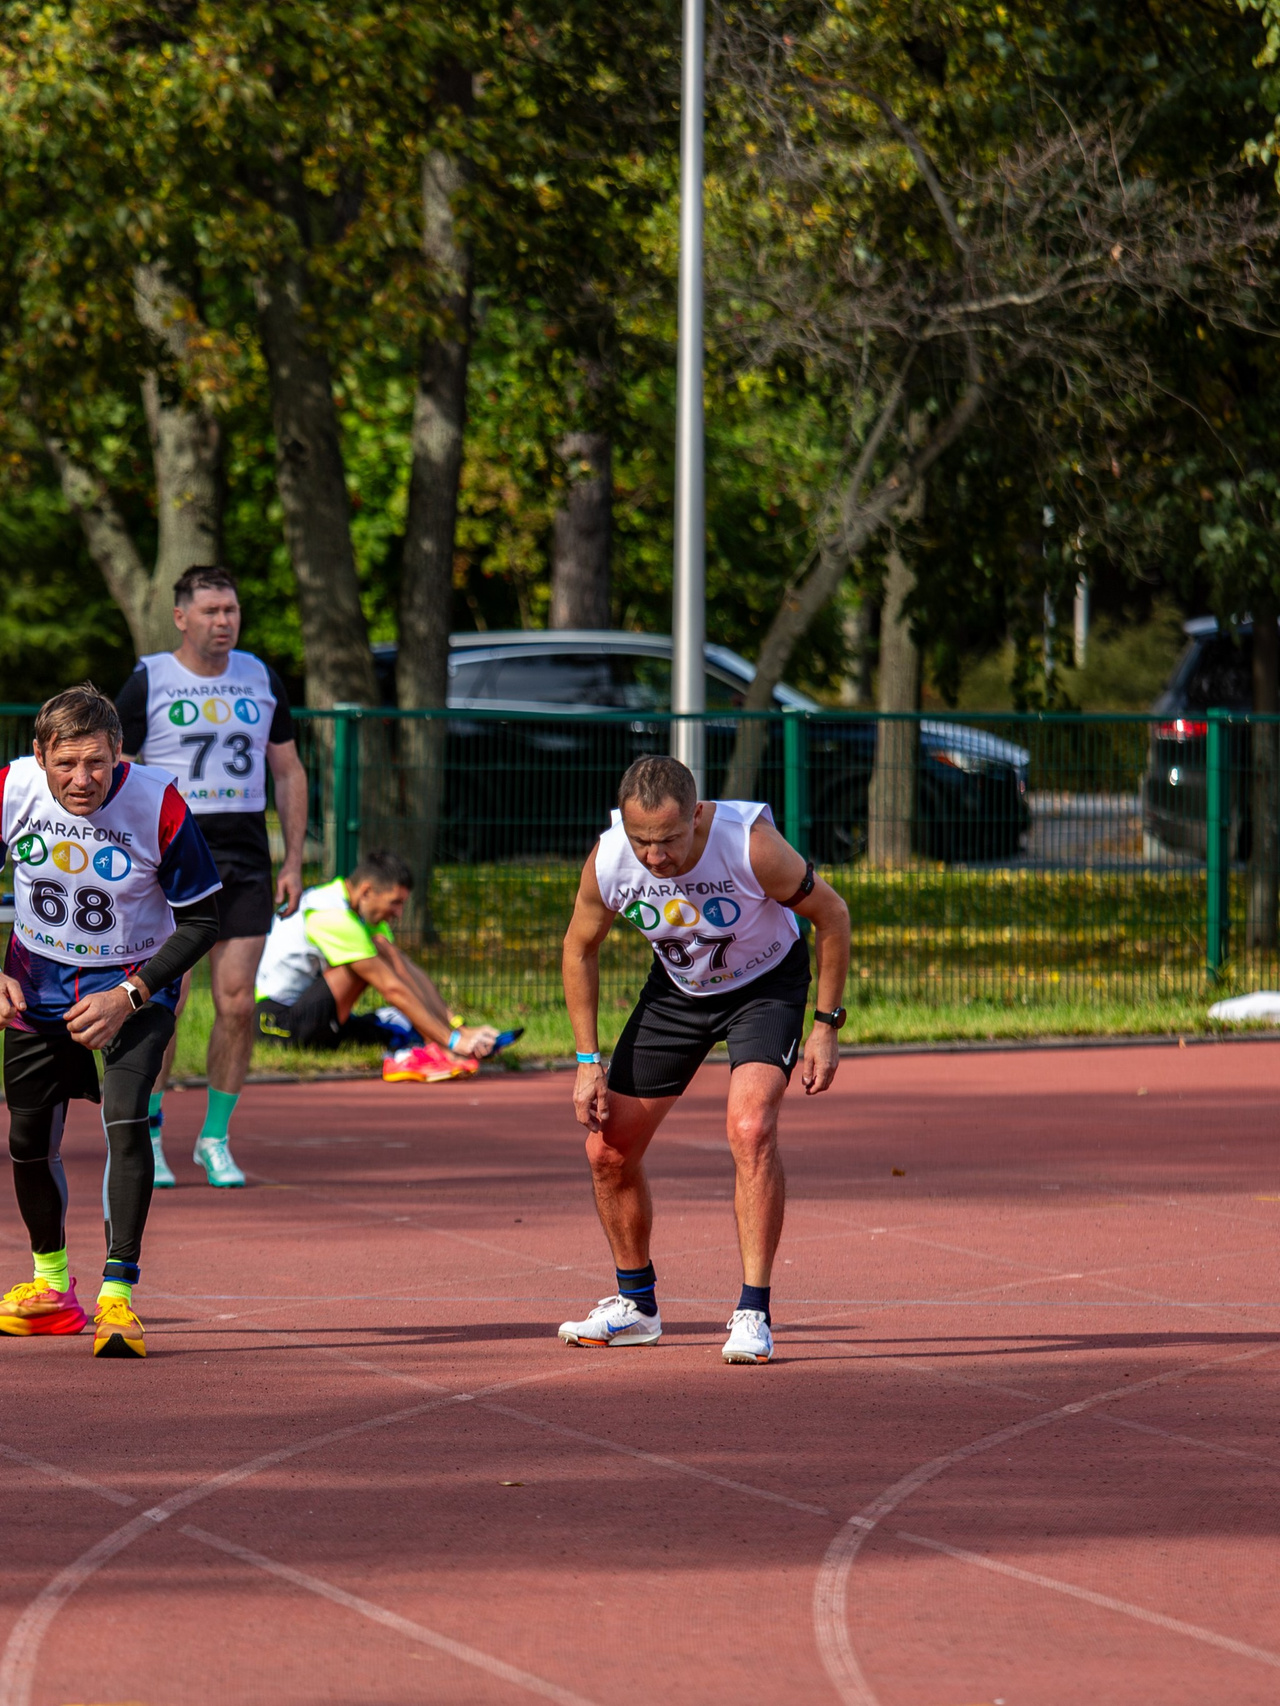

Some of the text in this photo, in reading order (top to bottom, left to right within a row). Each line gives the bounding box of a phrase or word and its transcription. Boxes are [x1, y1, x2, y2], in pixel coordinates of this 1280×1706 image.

[166, 685, 256, 698] VMARAFONE
[179, 731, 254, 782] 73
[17, 817, 133, 847] VMARAFONE
[29, 877, 117, 935] 68
[618, 879, 736, 899] VMARAFONE
[651, 932, 737, 972] 67
